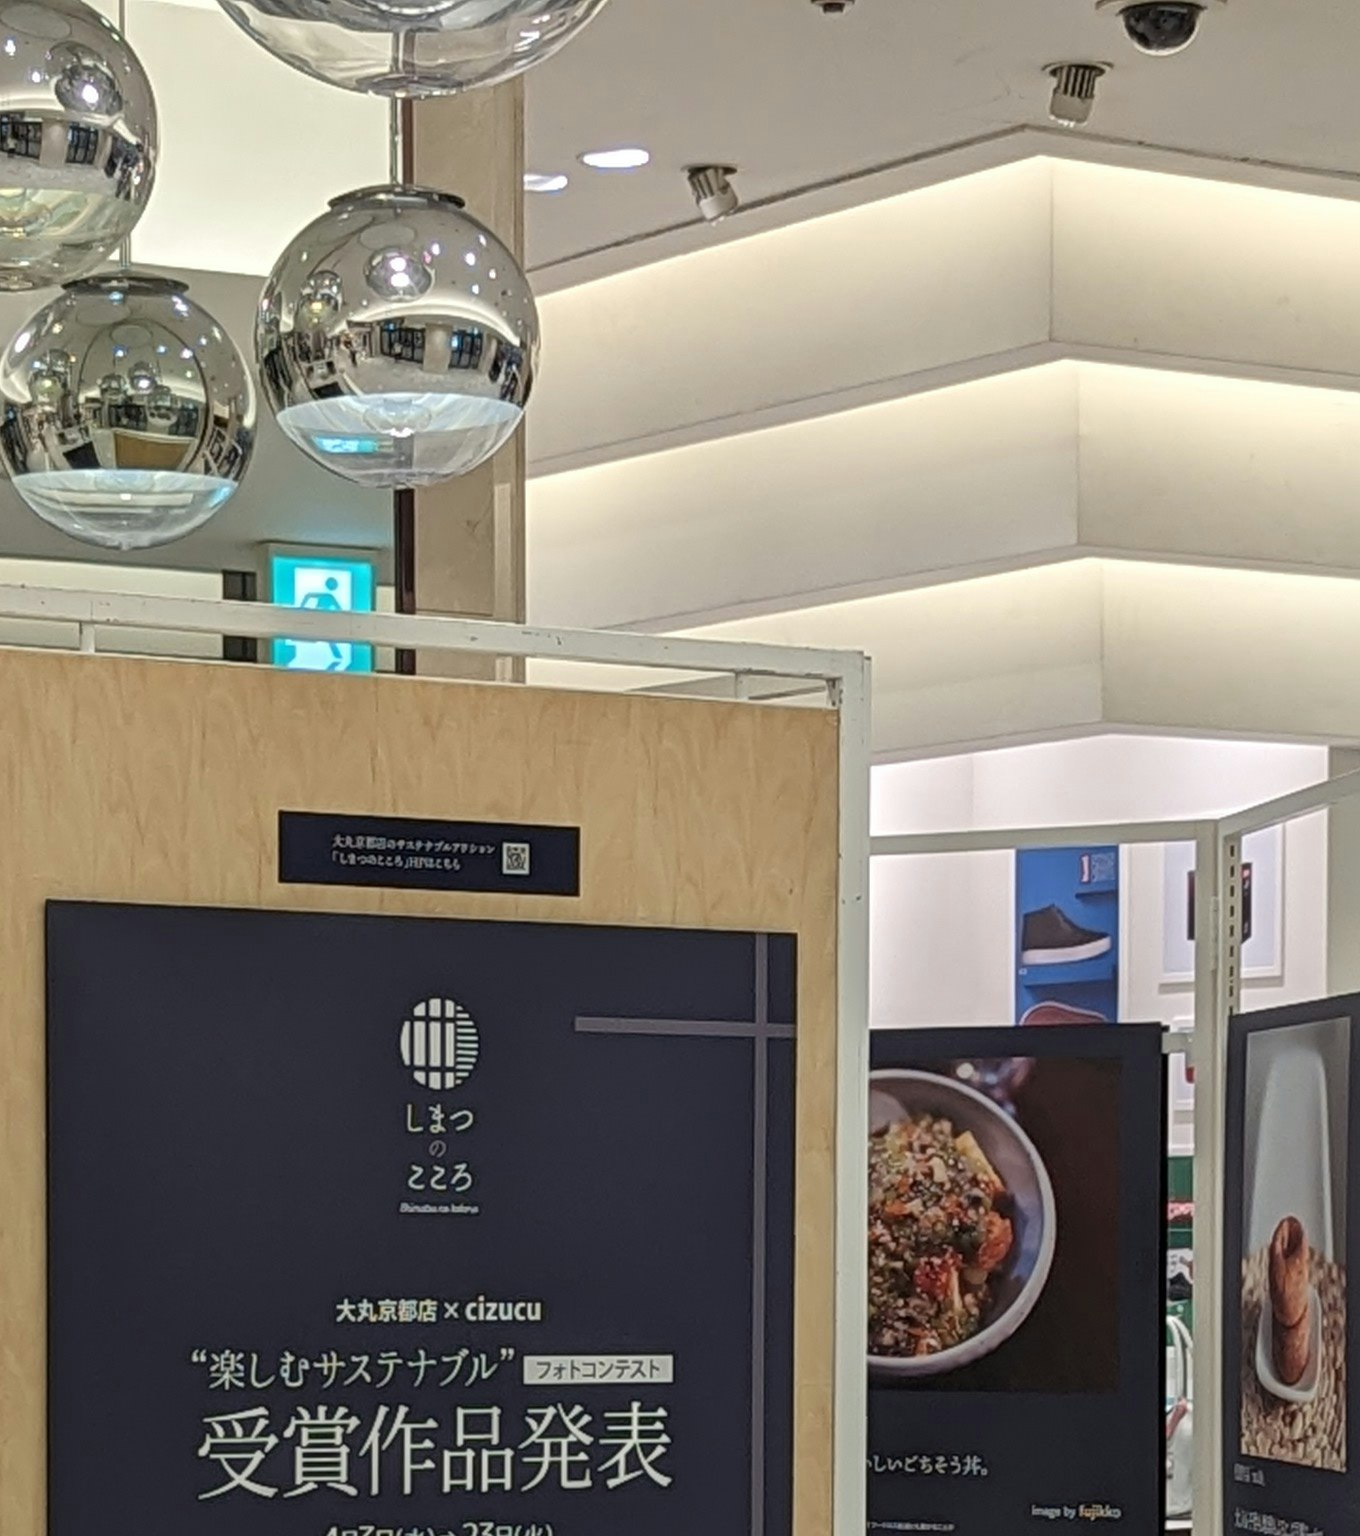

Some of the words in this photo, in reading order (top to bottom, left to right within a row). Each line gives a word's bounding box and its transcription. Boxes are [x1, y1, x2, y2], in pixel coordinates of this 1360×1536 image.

[407, 1104, 474, 1133] しまつ
[429, 1140, 446, 1158] の
[408, 1163, 472, 1191] こころ
[336, 1299, 437, 1322] 大丸京都店
[465, 1297, 542, 1321] cizucu
[537, 1360, 660, 1380] フォトコンテスト
[197, 1402, 673, 1500] 受賞作品発表
